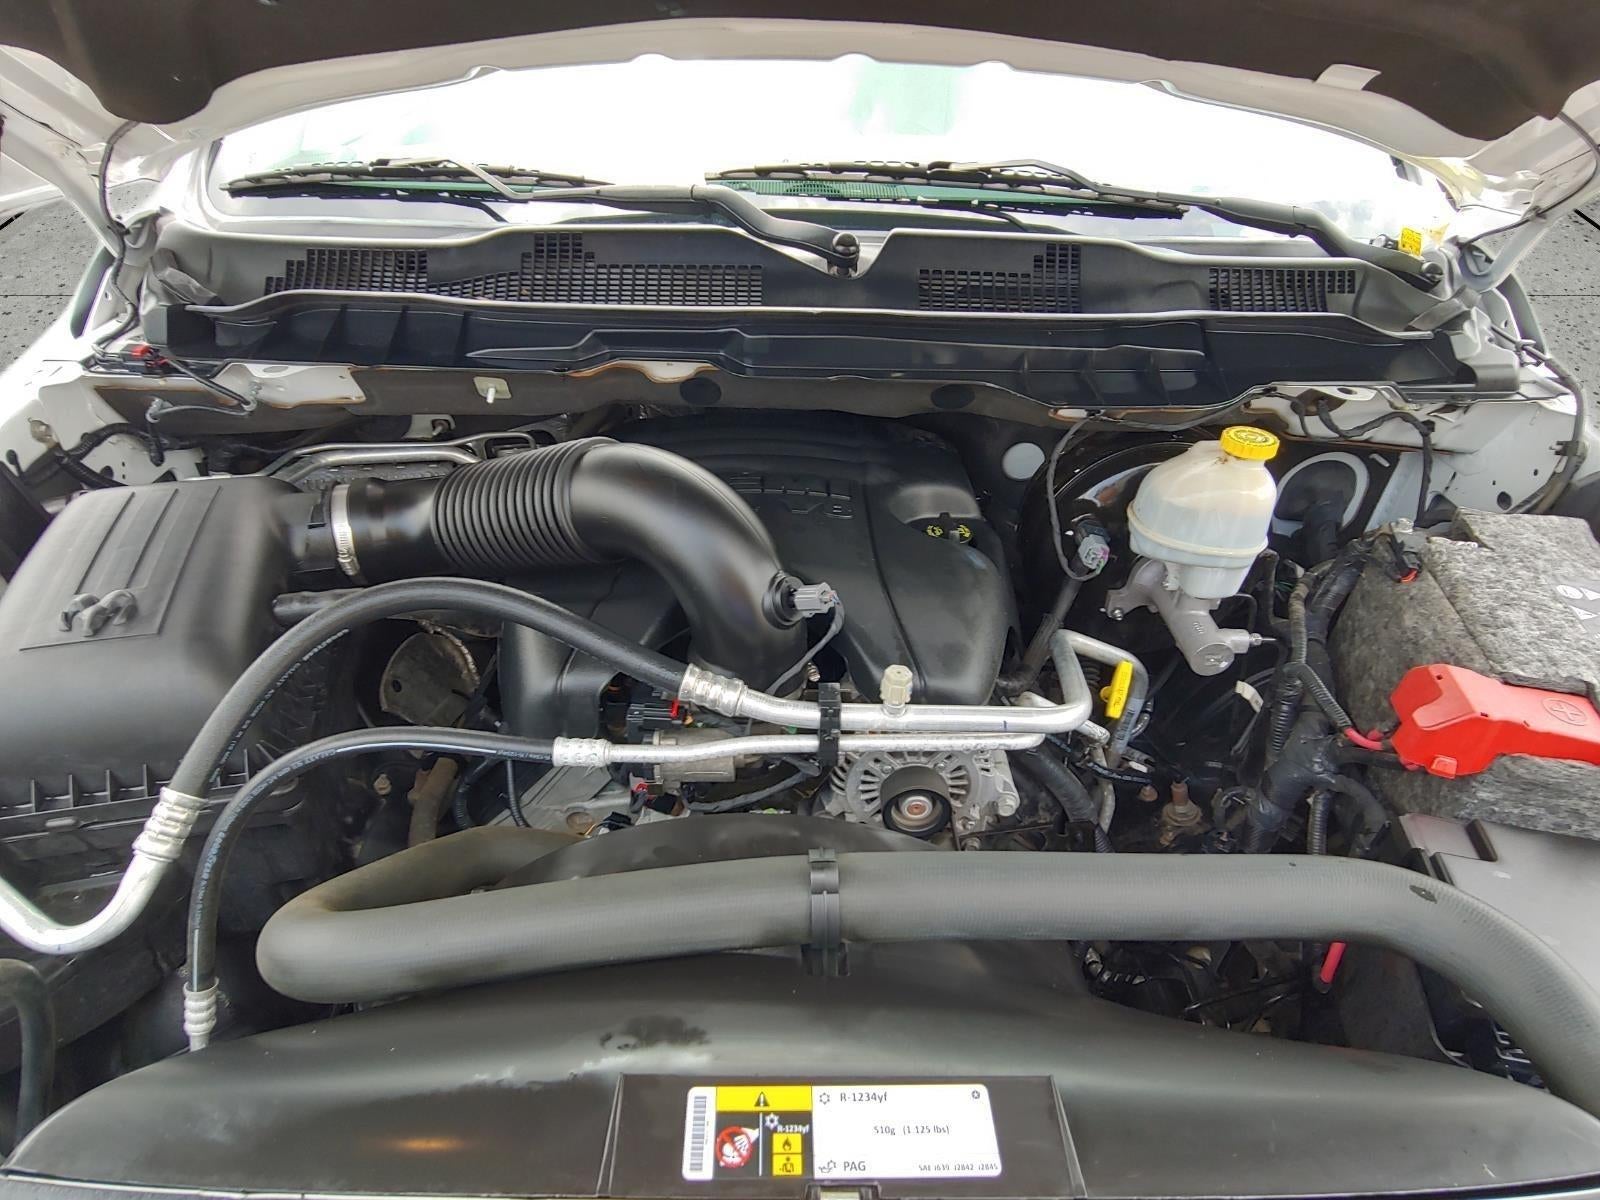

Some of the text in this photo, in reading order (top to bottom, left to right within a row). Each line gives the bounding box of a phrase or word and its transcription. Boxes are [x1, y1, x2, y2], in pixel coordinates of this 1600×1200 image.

[840, 1091, 888, 1104] R-1234yf
[873, 1124, 950, 1136] 510g (1125 lbs)
[843, 1160, 867, 1172] PAG
